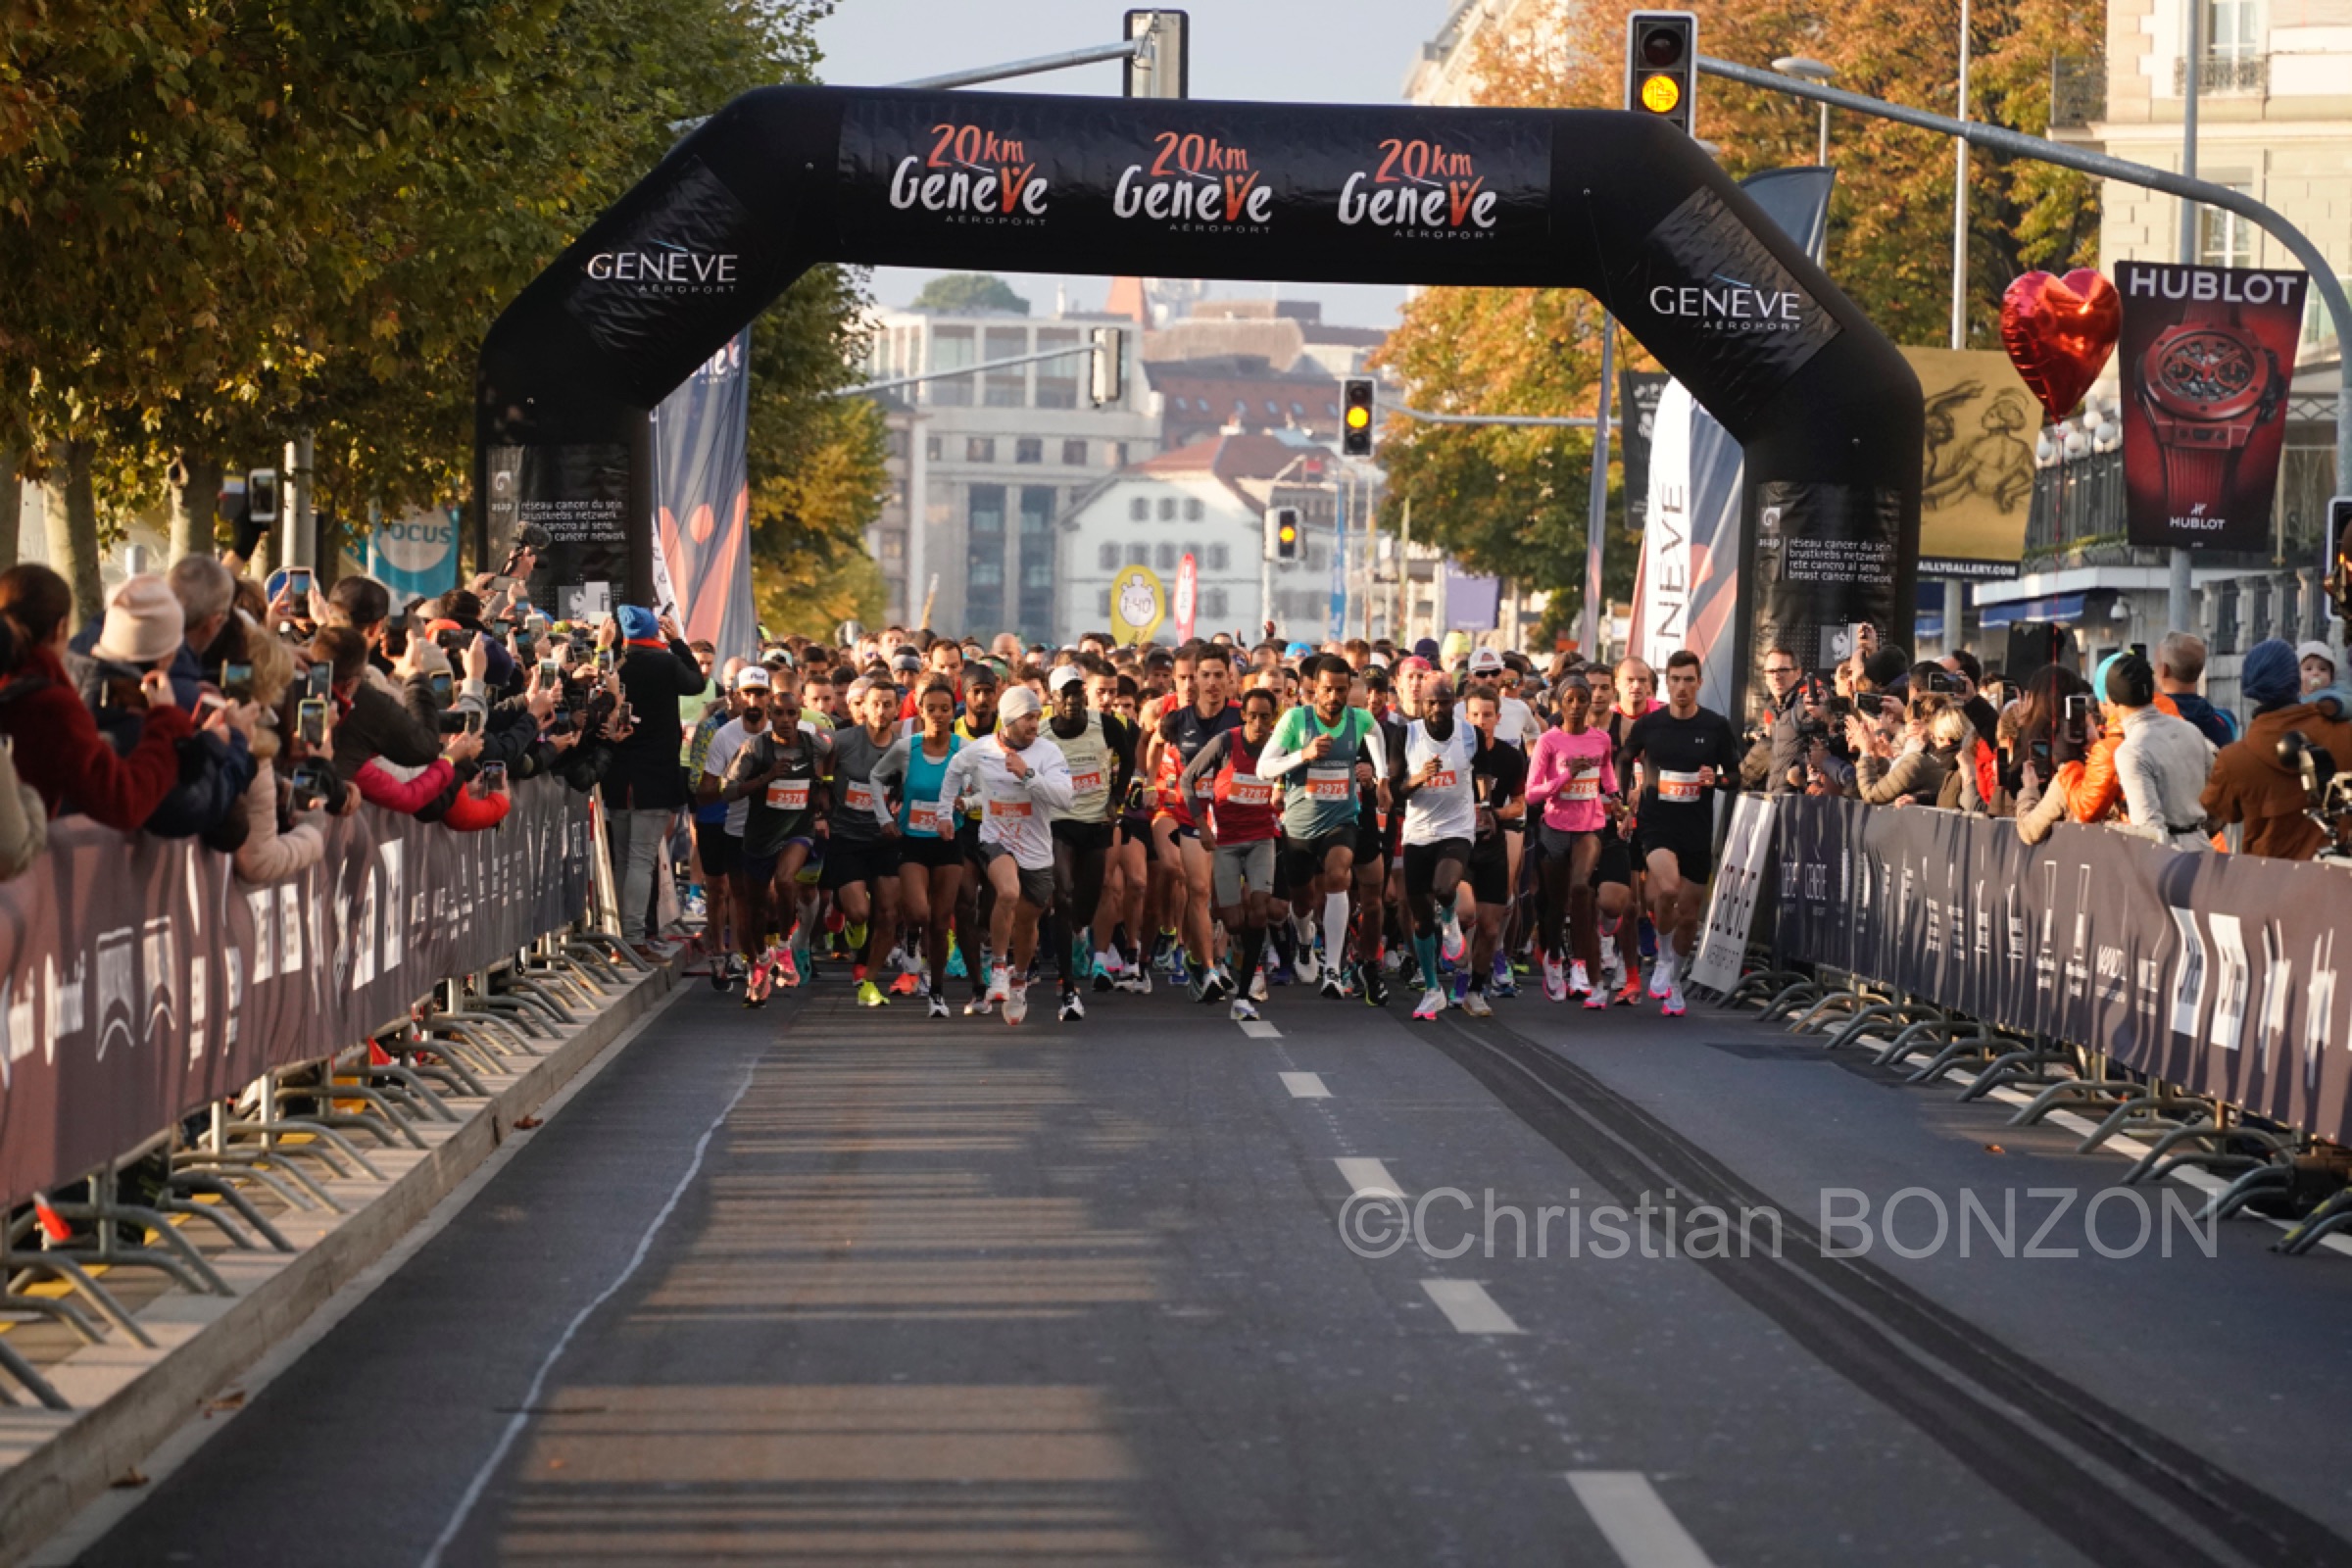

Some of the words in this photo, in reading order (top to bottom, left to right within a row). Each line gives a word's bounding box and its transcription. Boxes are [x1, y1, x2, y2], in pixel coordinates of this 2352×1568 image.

[2130, 266, 2299, 306] HUBLOT
[555, 501, 589, 511] cancer
[591, 498, 604, 509] du
[575, 511, 617, 520] netzwerk
[2169, 516, 2227, 530] HUBLOT
[378, 520, 453, 545] OCUS
[554, 531, 588, 541] cancer
[590, 530, 626, 541] network
[1824, 540, 1859, 550] cancer
[1860, 540, 1873, 551] du
[1788, 549, 1841, 560] brustkrebs
[1843, 551, 1886, 562] netzwerk
[1788, 560, 1808, 569] rete
[1810, 561, 1845, 570] cancro
[1918, 560, 2017, 576] AILLYGALLERY.COM
[1788, 570, 1820, 580] breast
[1820, 571, 1855, 582] cancer
[1857, 573, 1893, 583] network
